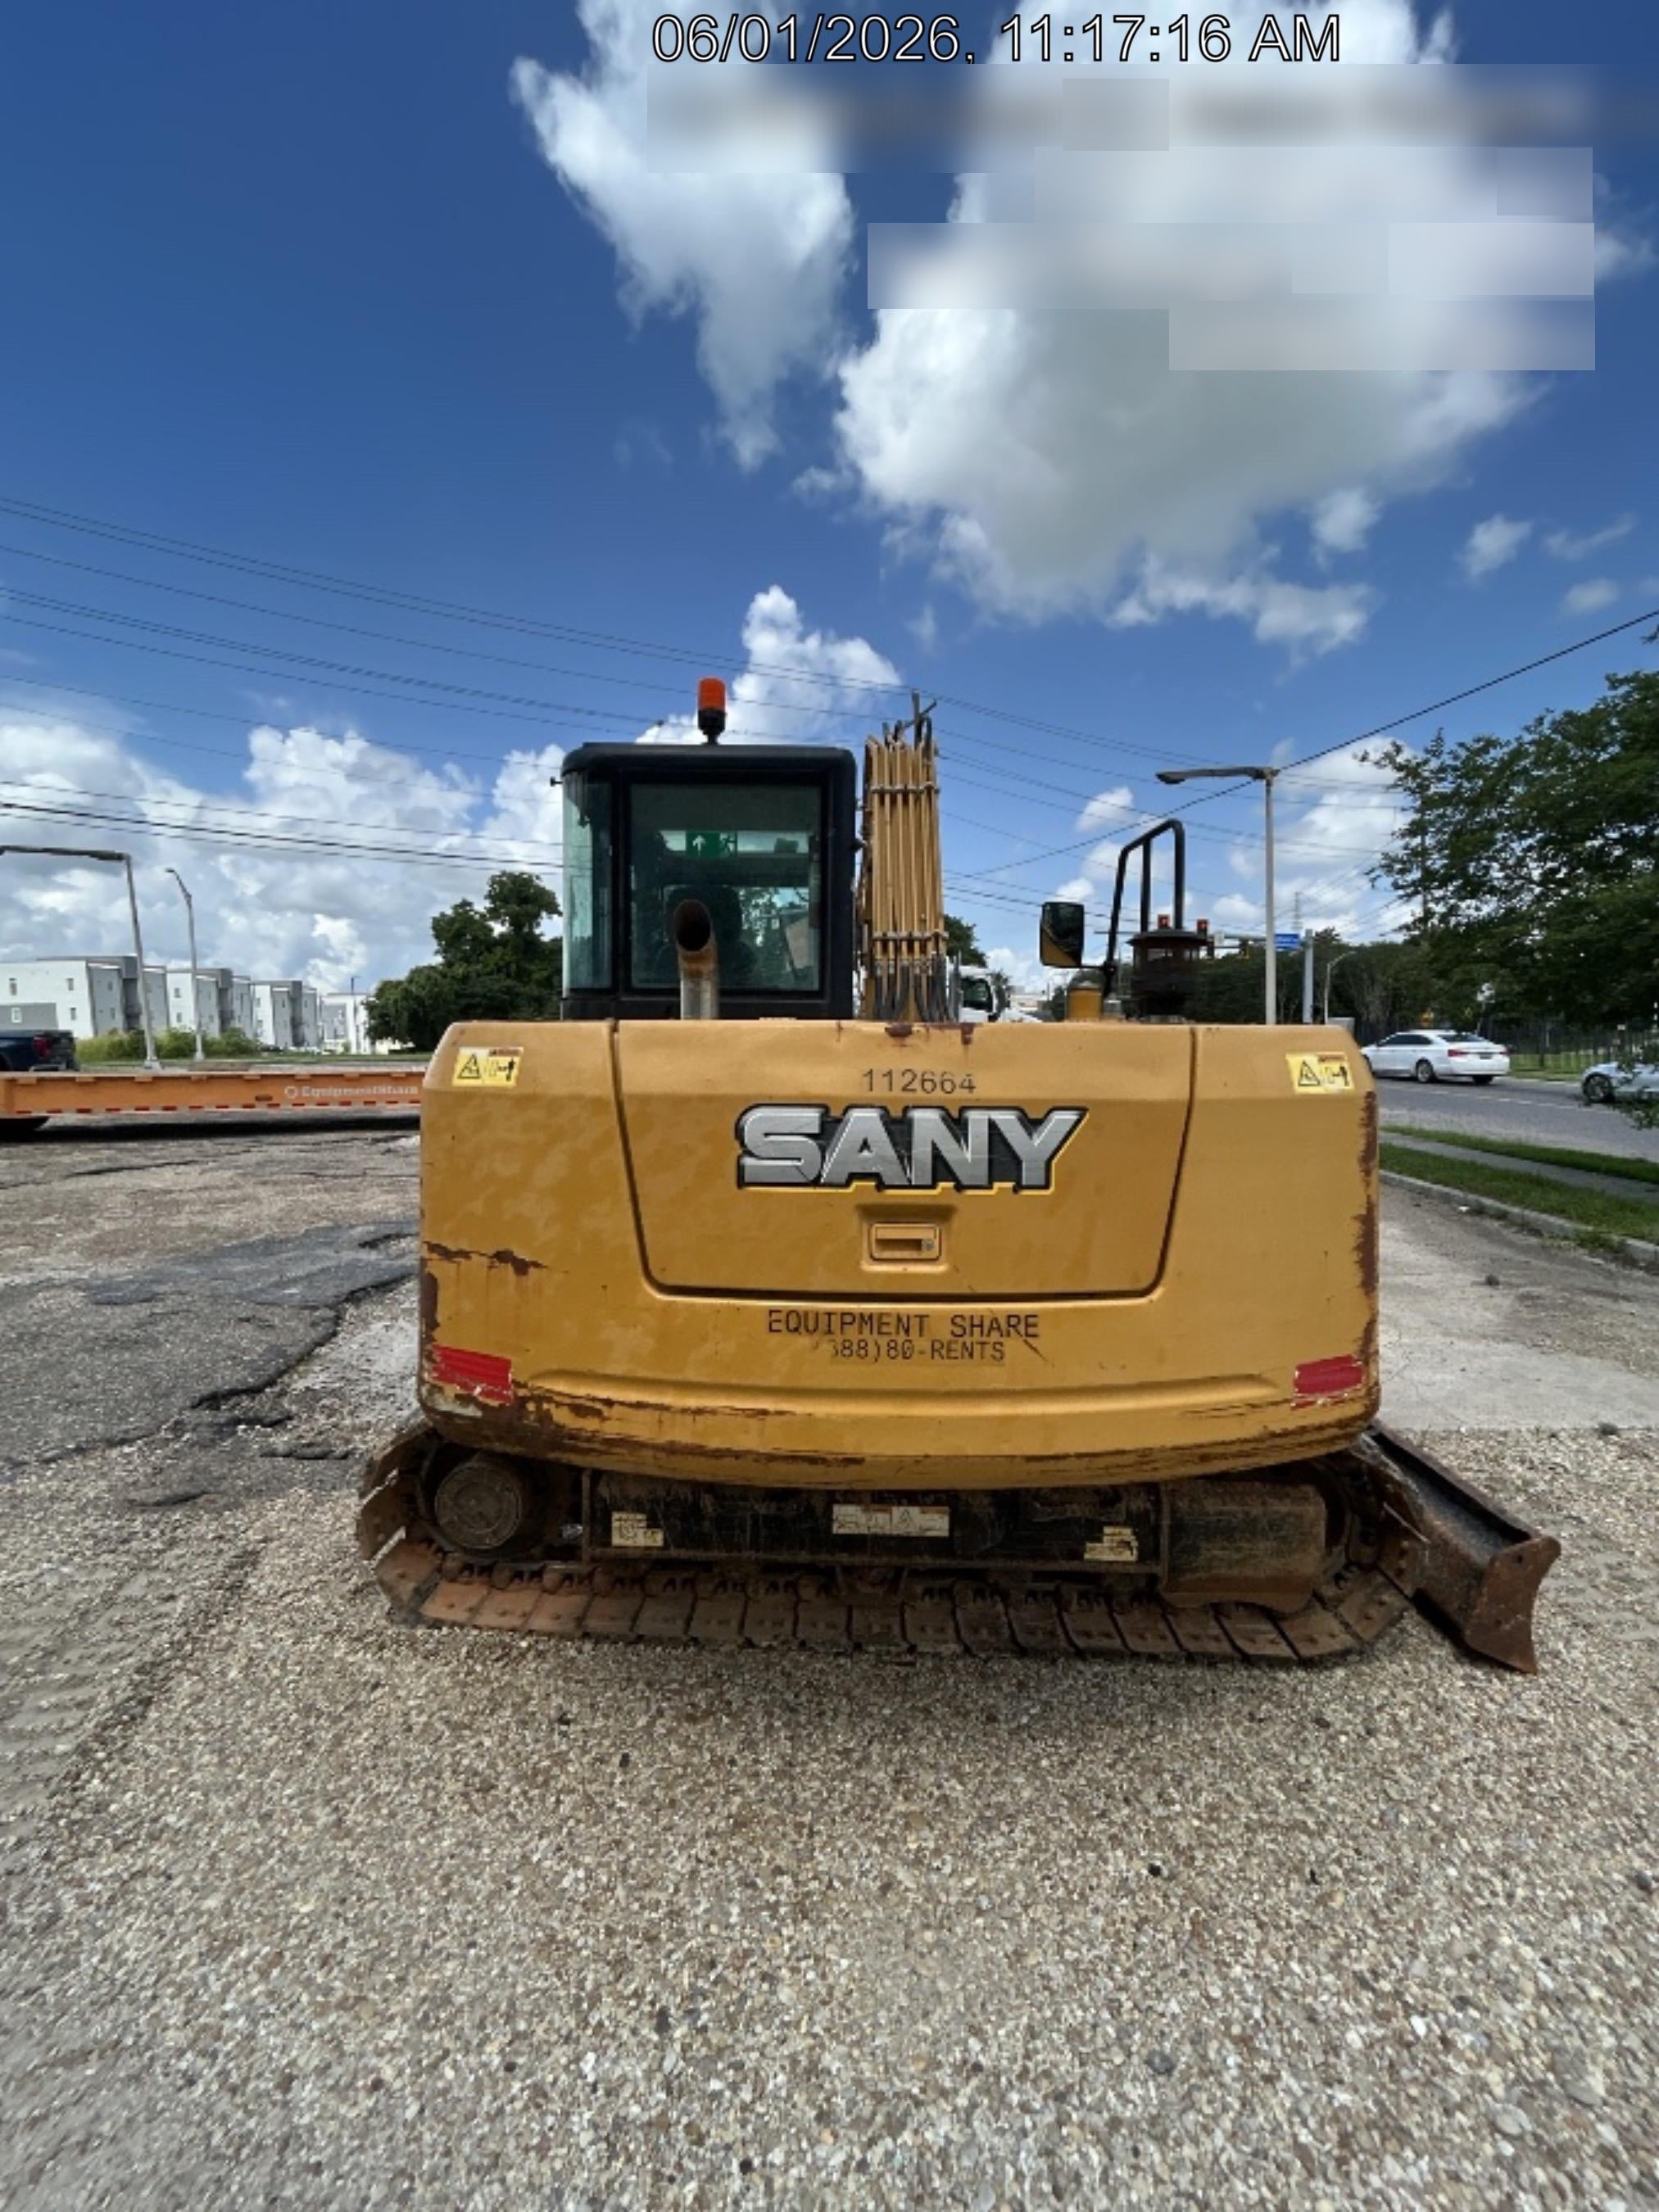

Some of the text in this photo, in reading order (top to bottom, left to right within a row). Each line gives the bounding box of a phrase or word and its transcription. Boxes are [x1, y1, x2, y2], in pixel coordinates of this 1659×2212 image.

[863, 1068, 977, 1095] 112664
[736, 1103, 1090, 1194] SANY
[768, 1309, 1041, 1339] EQUIPMENT SHARE
